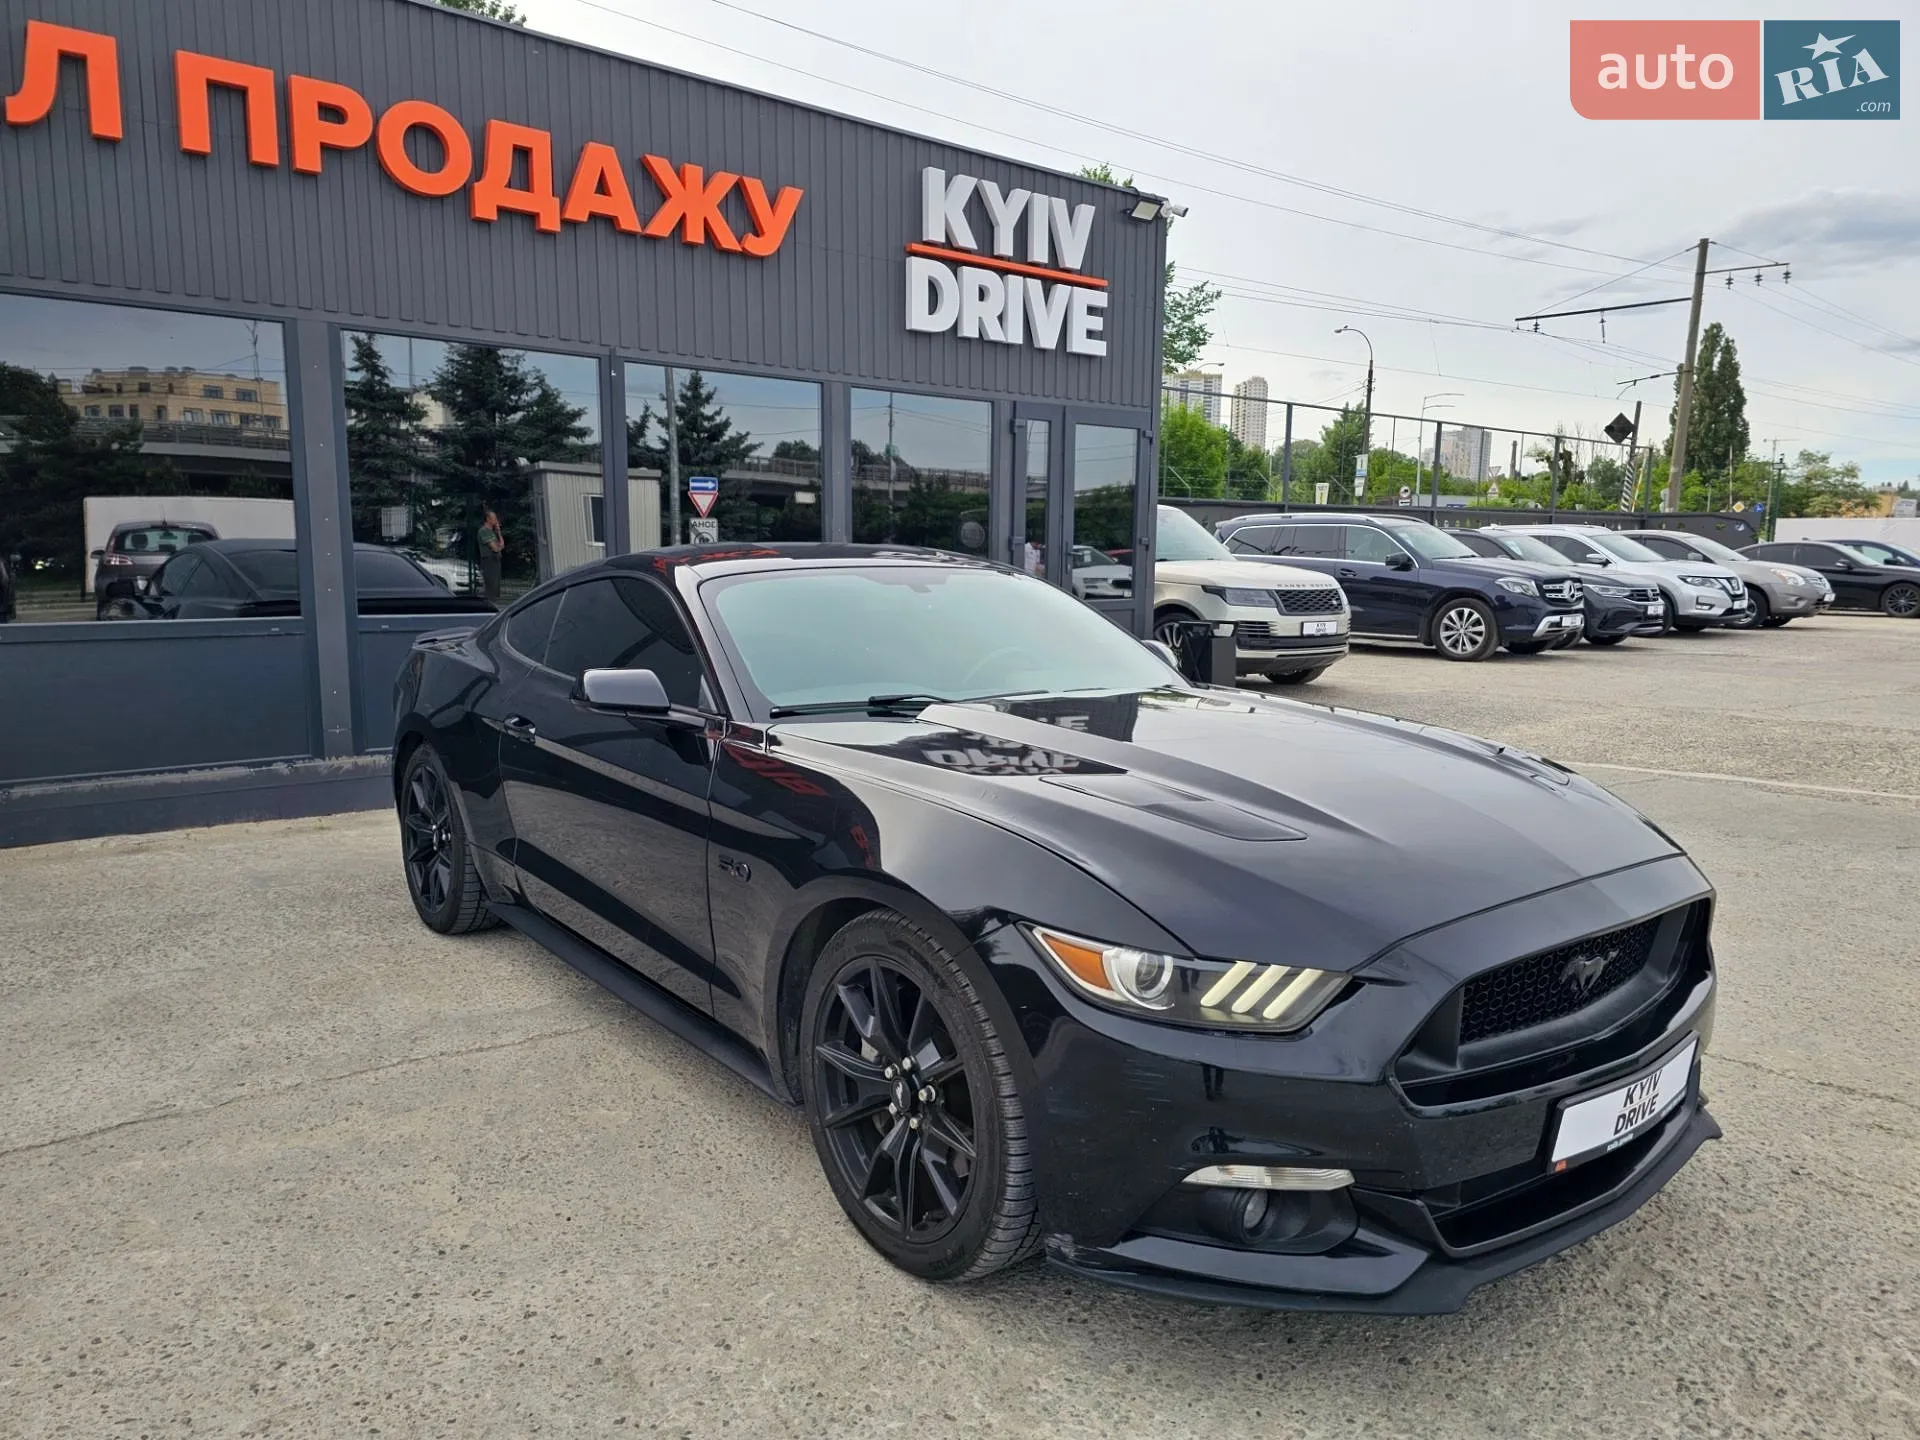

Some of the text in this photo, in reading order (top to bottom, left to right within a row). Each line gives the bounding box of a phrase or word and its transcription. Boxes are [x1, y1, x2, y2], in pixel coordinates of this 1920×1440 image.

[5, 19, 803, 257] Л ПРОДАЖУ
[922, 166, 1095, 270] KYIV
[905, 255, 1108, 357] DRIVE
[1613, 1092, 1659, 1137] DRIVE
[1623, 1069, 1663, 1108] KYIV
